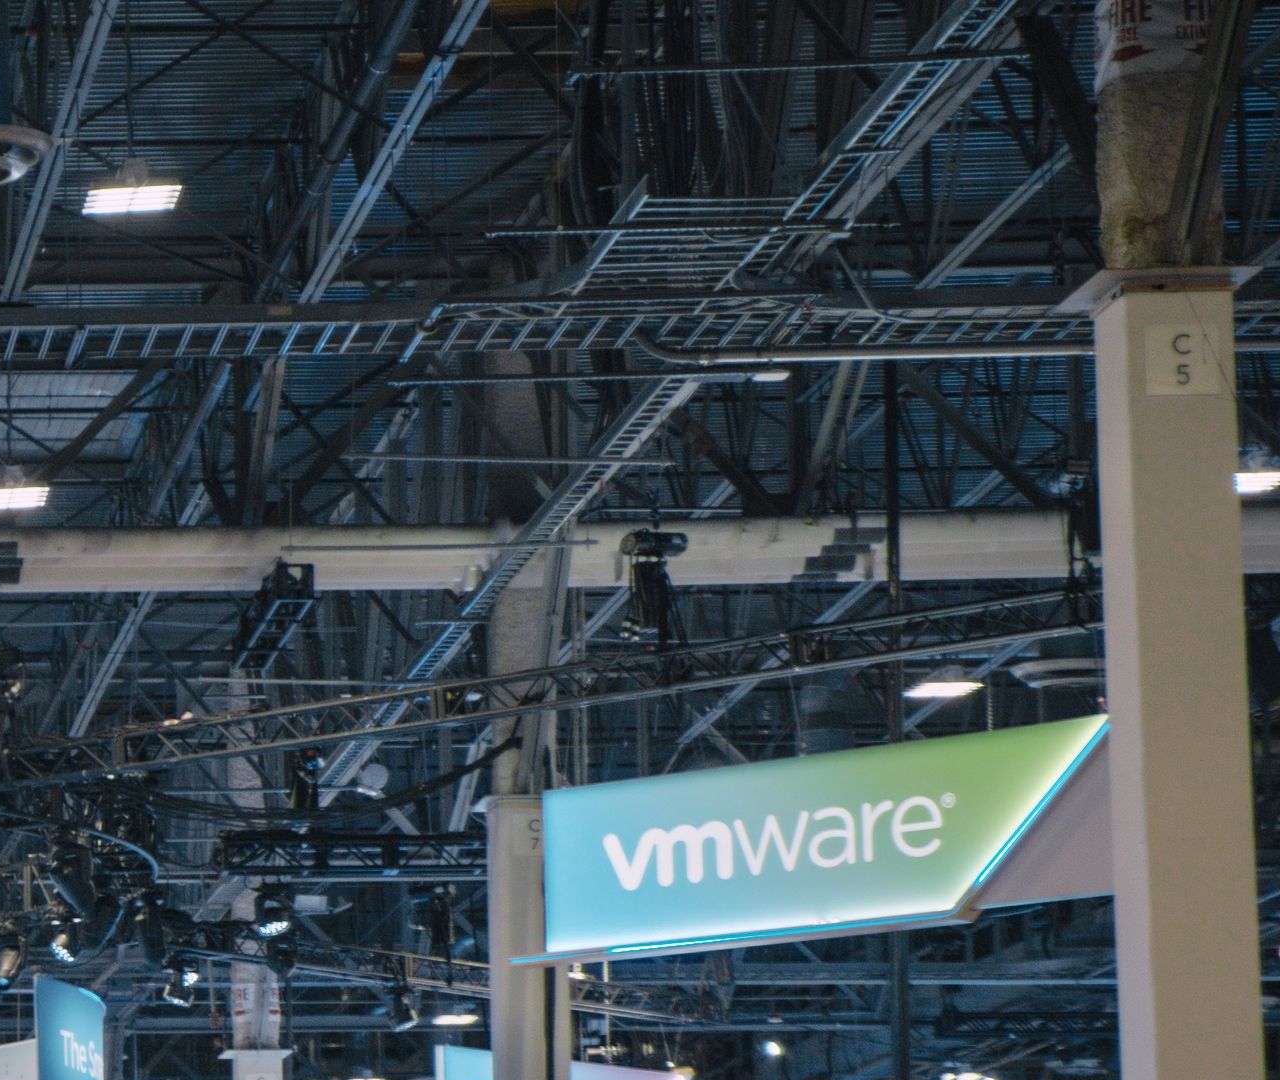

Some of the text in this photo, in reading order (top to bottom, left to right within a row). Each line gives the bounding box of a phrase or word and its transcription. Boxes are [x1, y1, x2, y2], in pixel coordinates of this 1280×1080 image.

[1173, 334, 1192, 356] C
[1176, 364, 1190, 386] 5
[60, 1029, 88, 1074] The
